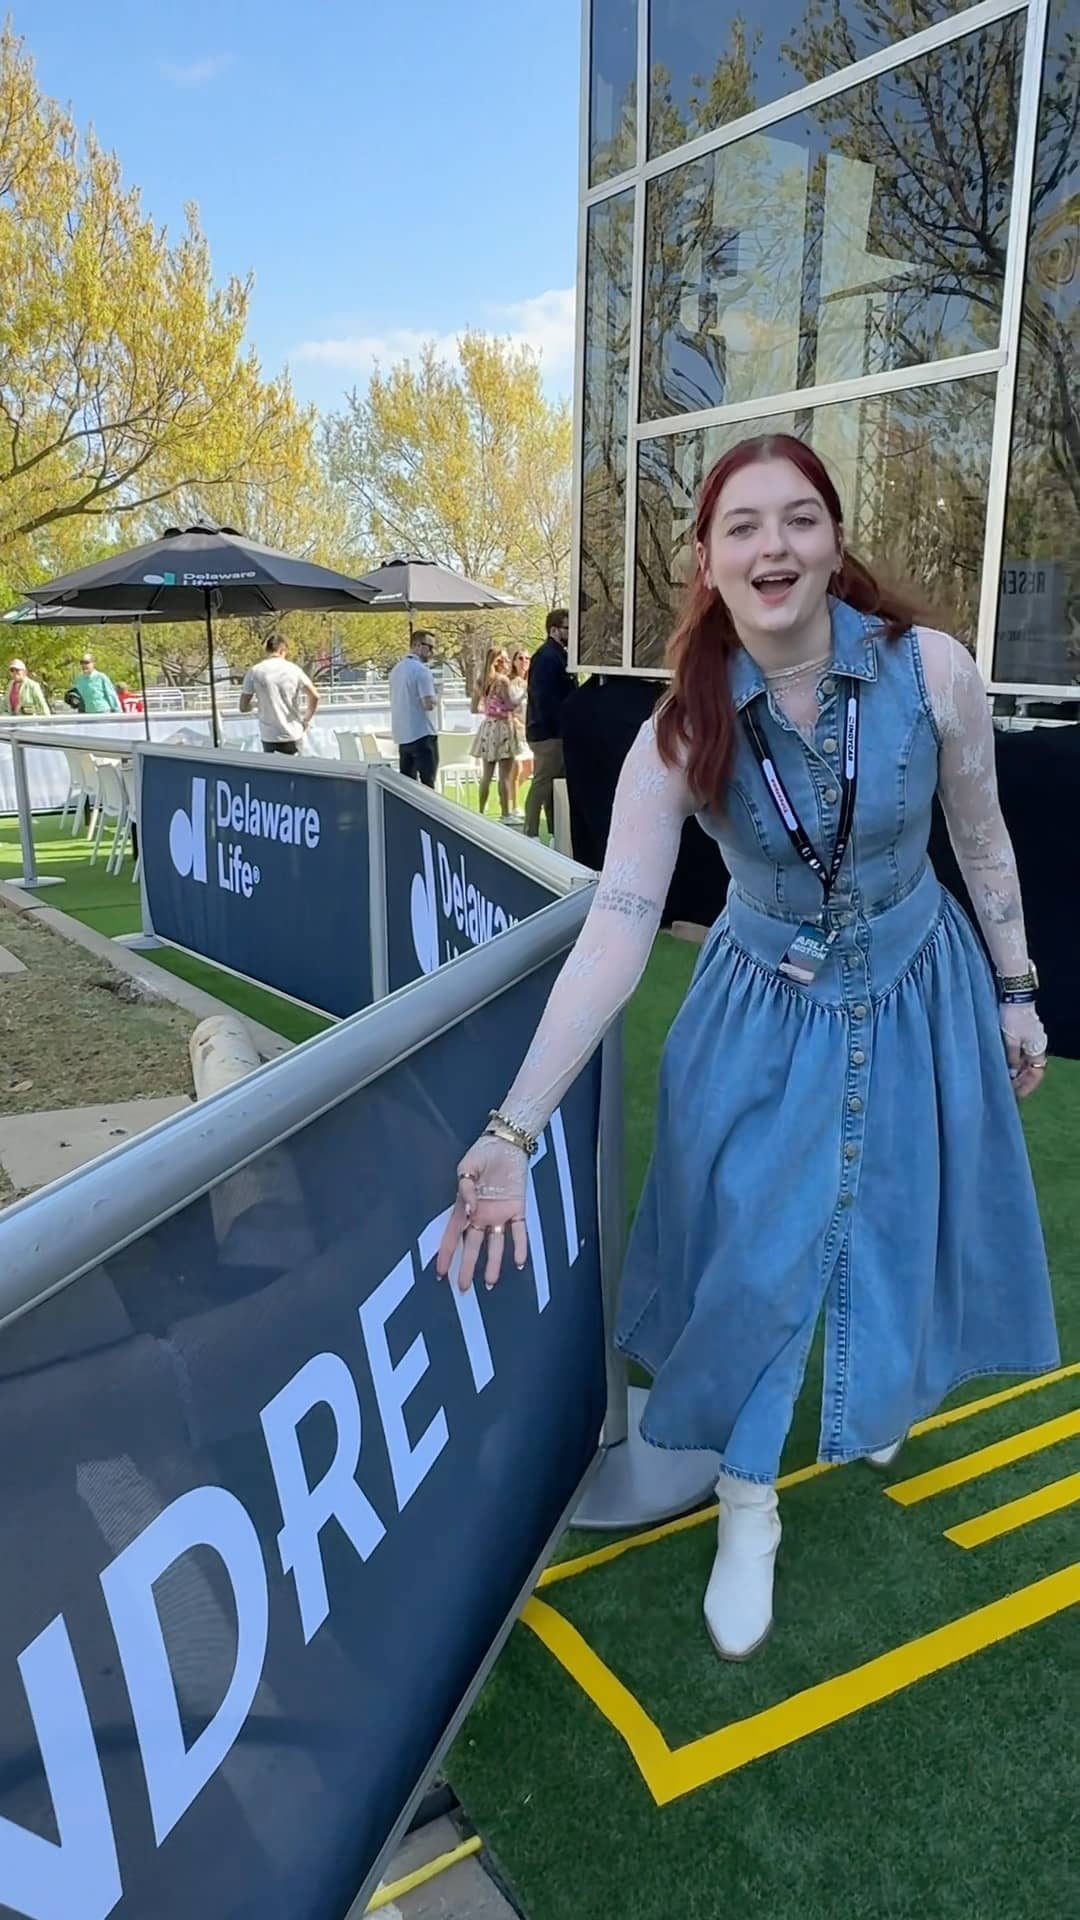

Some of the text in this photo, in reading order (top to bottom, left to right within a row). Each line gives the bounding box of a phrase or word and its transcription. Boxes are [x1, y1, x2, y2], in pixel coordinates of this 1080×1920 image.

[183, 571, 257, 580] Delaware
[216, 780, 320, 849] Delaware
[437, 841, 519, 945] Delawa
